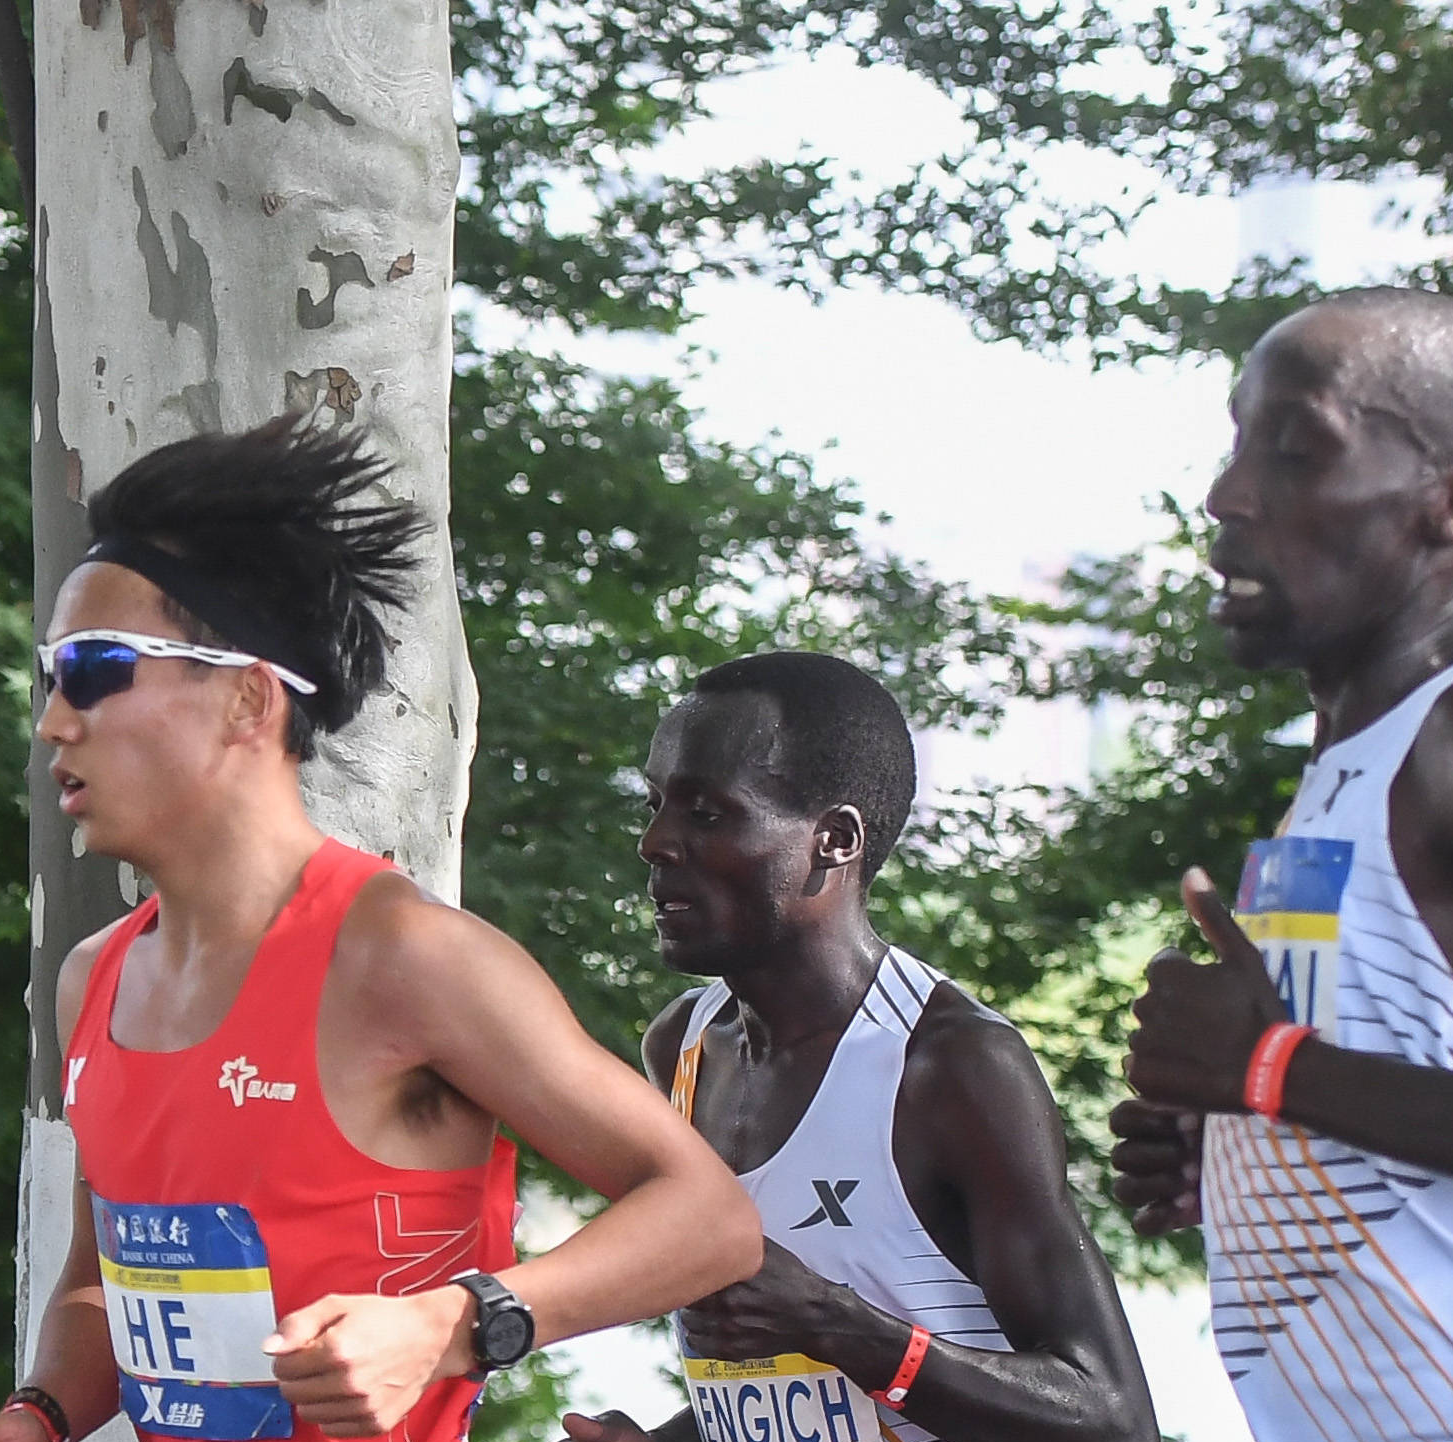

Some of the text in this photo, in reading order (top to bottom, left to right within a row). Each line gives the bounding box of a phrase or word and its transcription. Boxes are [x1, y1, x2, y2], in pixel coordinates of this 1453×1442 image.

[116, 1214, 190, 1247] 中国银行
[160, 1253, 196, 1265] CHINA
[122, 1296, 195, 1373] HE
